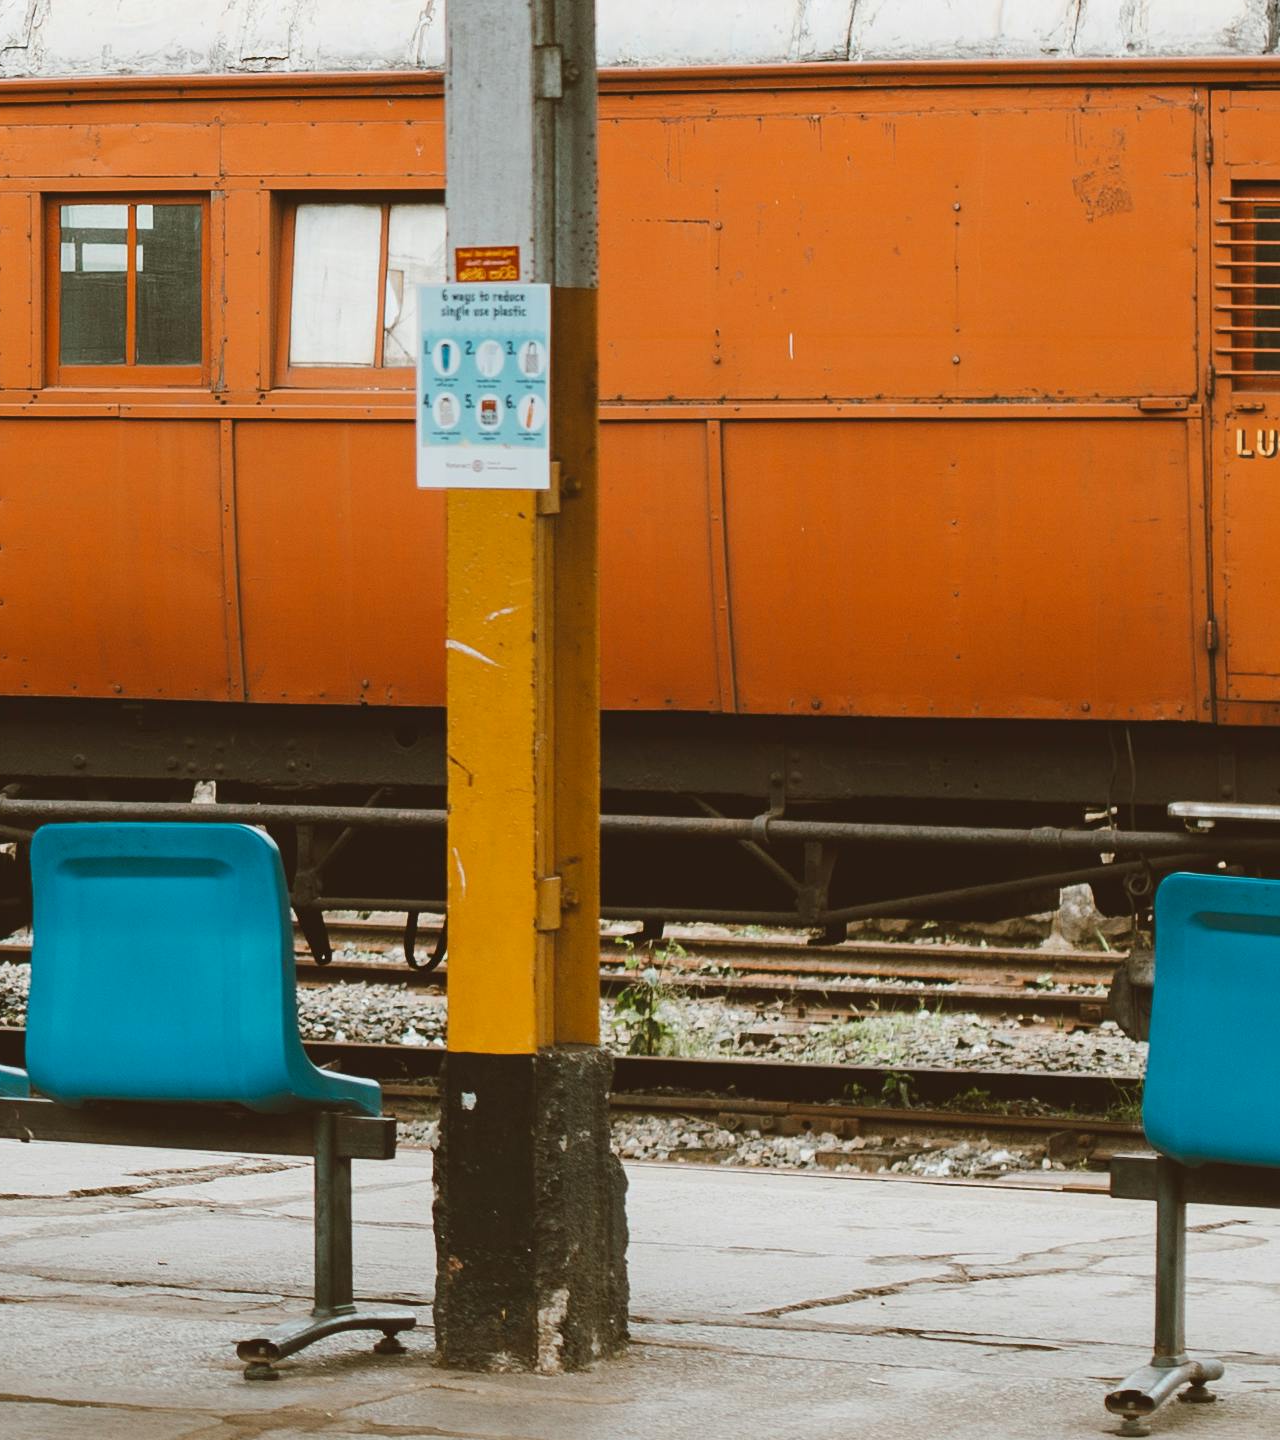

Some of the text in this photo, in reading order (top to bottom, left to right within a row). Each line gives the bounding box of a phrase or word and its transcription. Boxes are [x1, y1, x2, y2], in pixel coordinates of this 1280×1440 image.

[441, 289, 526, 305] 6 ways to reduce
[441, 305, 528, 321] single use plastic
